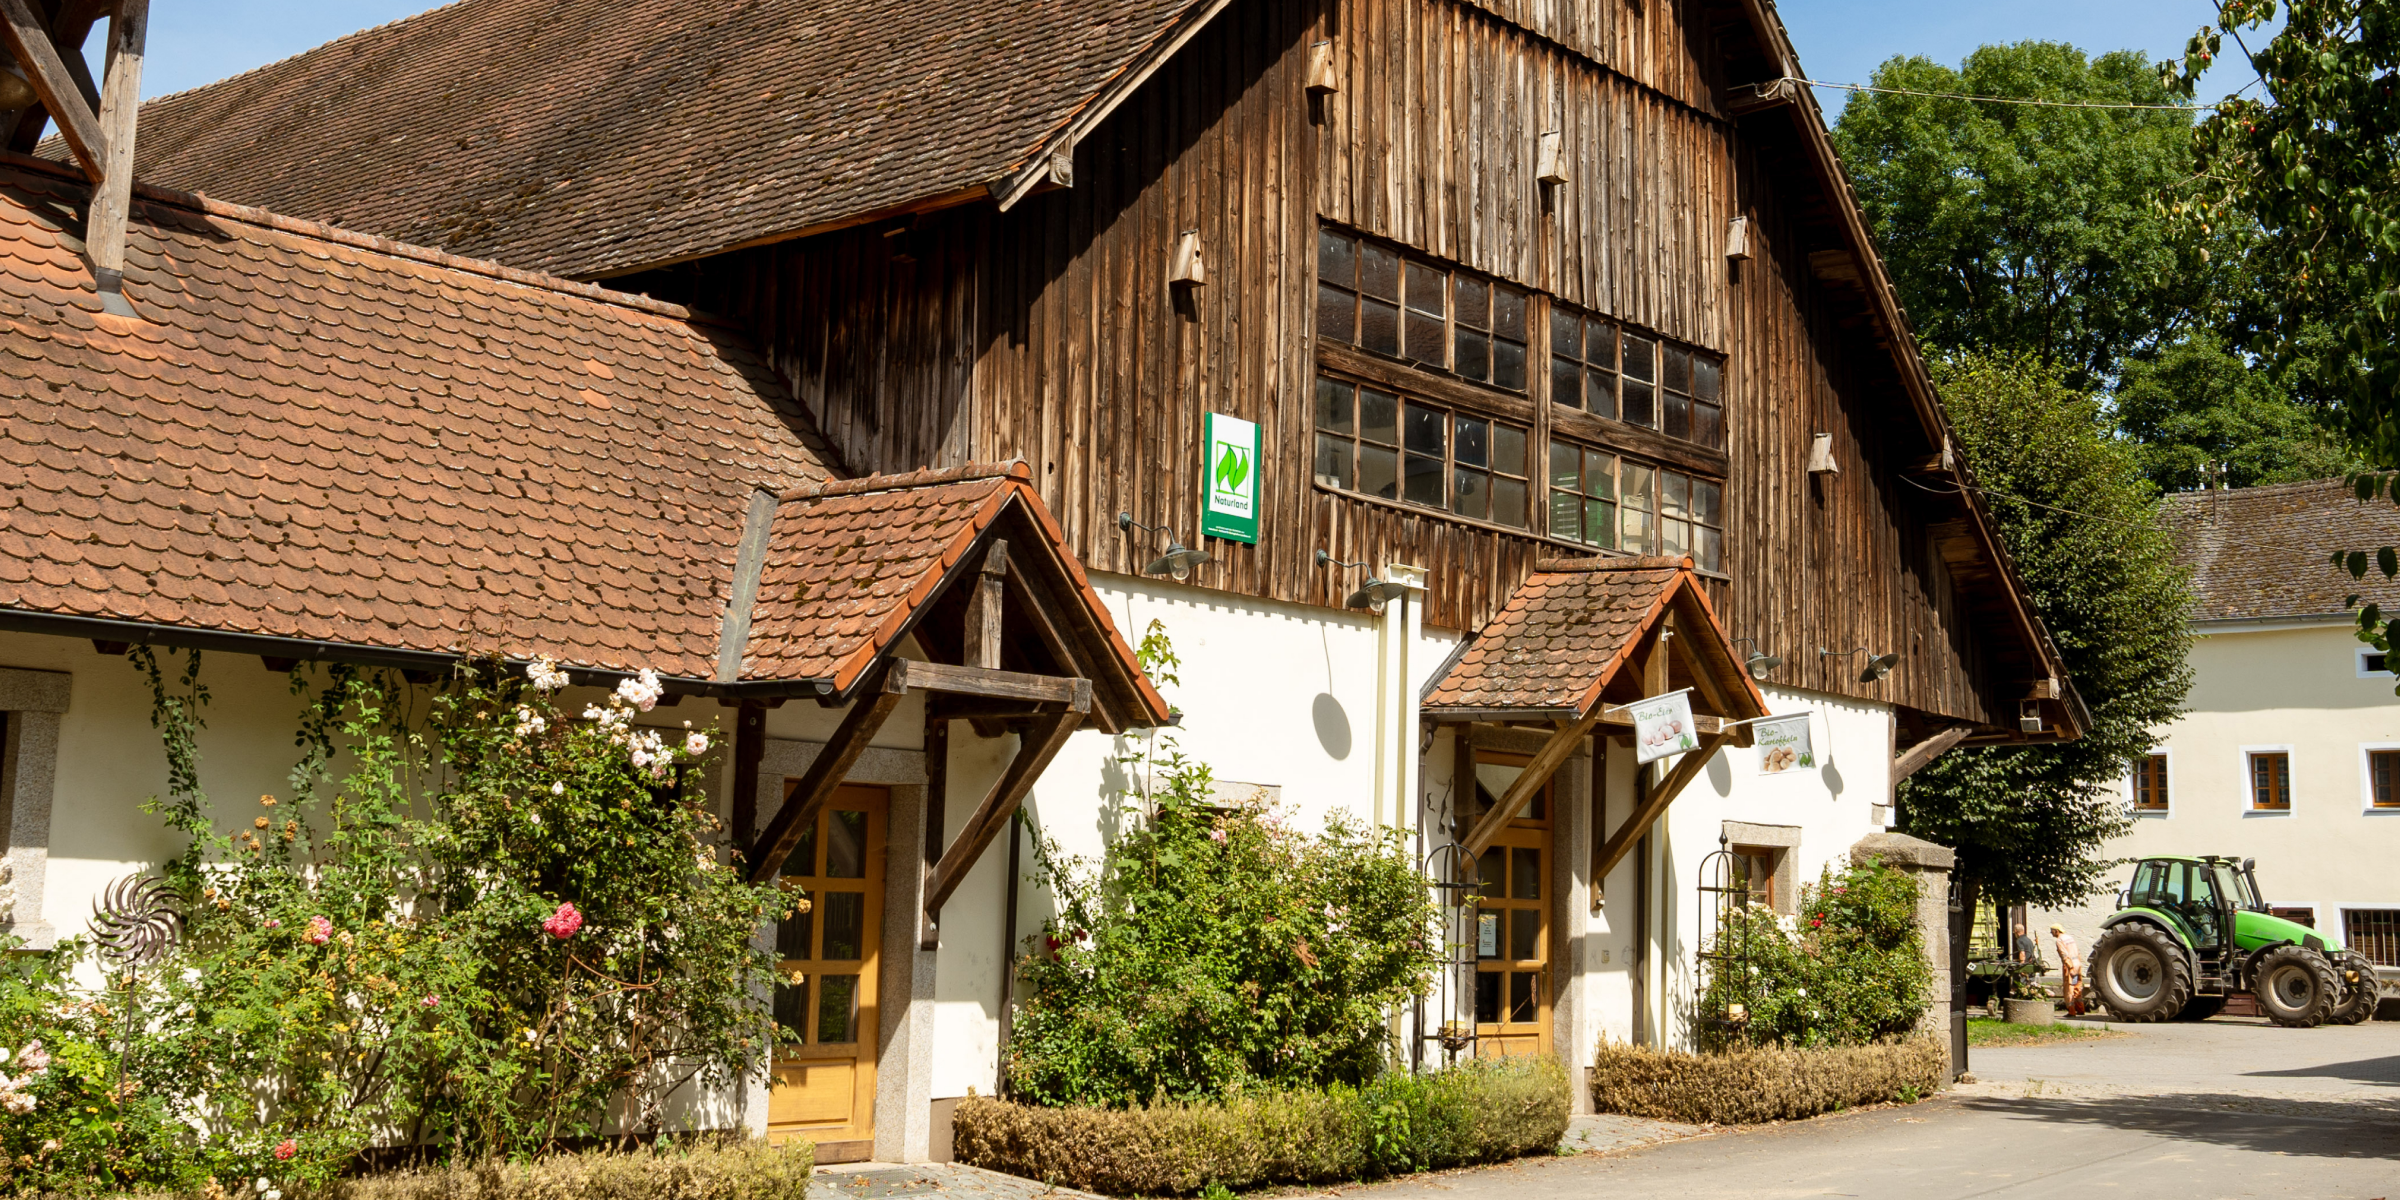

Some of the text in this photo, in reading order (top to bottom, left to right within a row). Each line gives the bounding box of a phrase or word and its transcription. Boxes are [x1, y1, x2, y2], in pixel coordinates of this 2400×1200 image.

[1214, 495, 1248, 510] Naturland
[1636, 707, 1673, 721] Bio-Eier
[1758, 727, 1778, 737] Bio-
[1758, 735, 1798, 746] Kartoffeln
